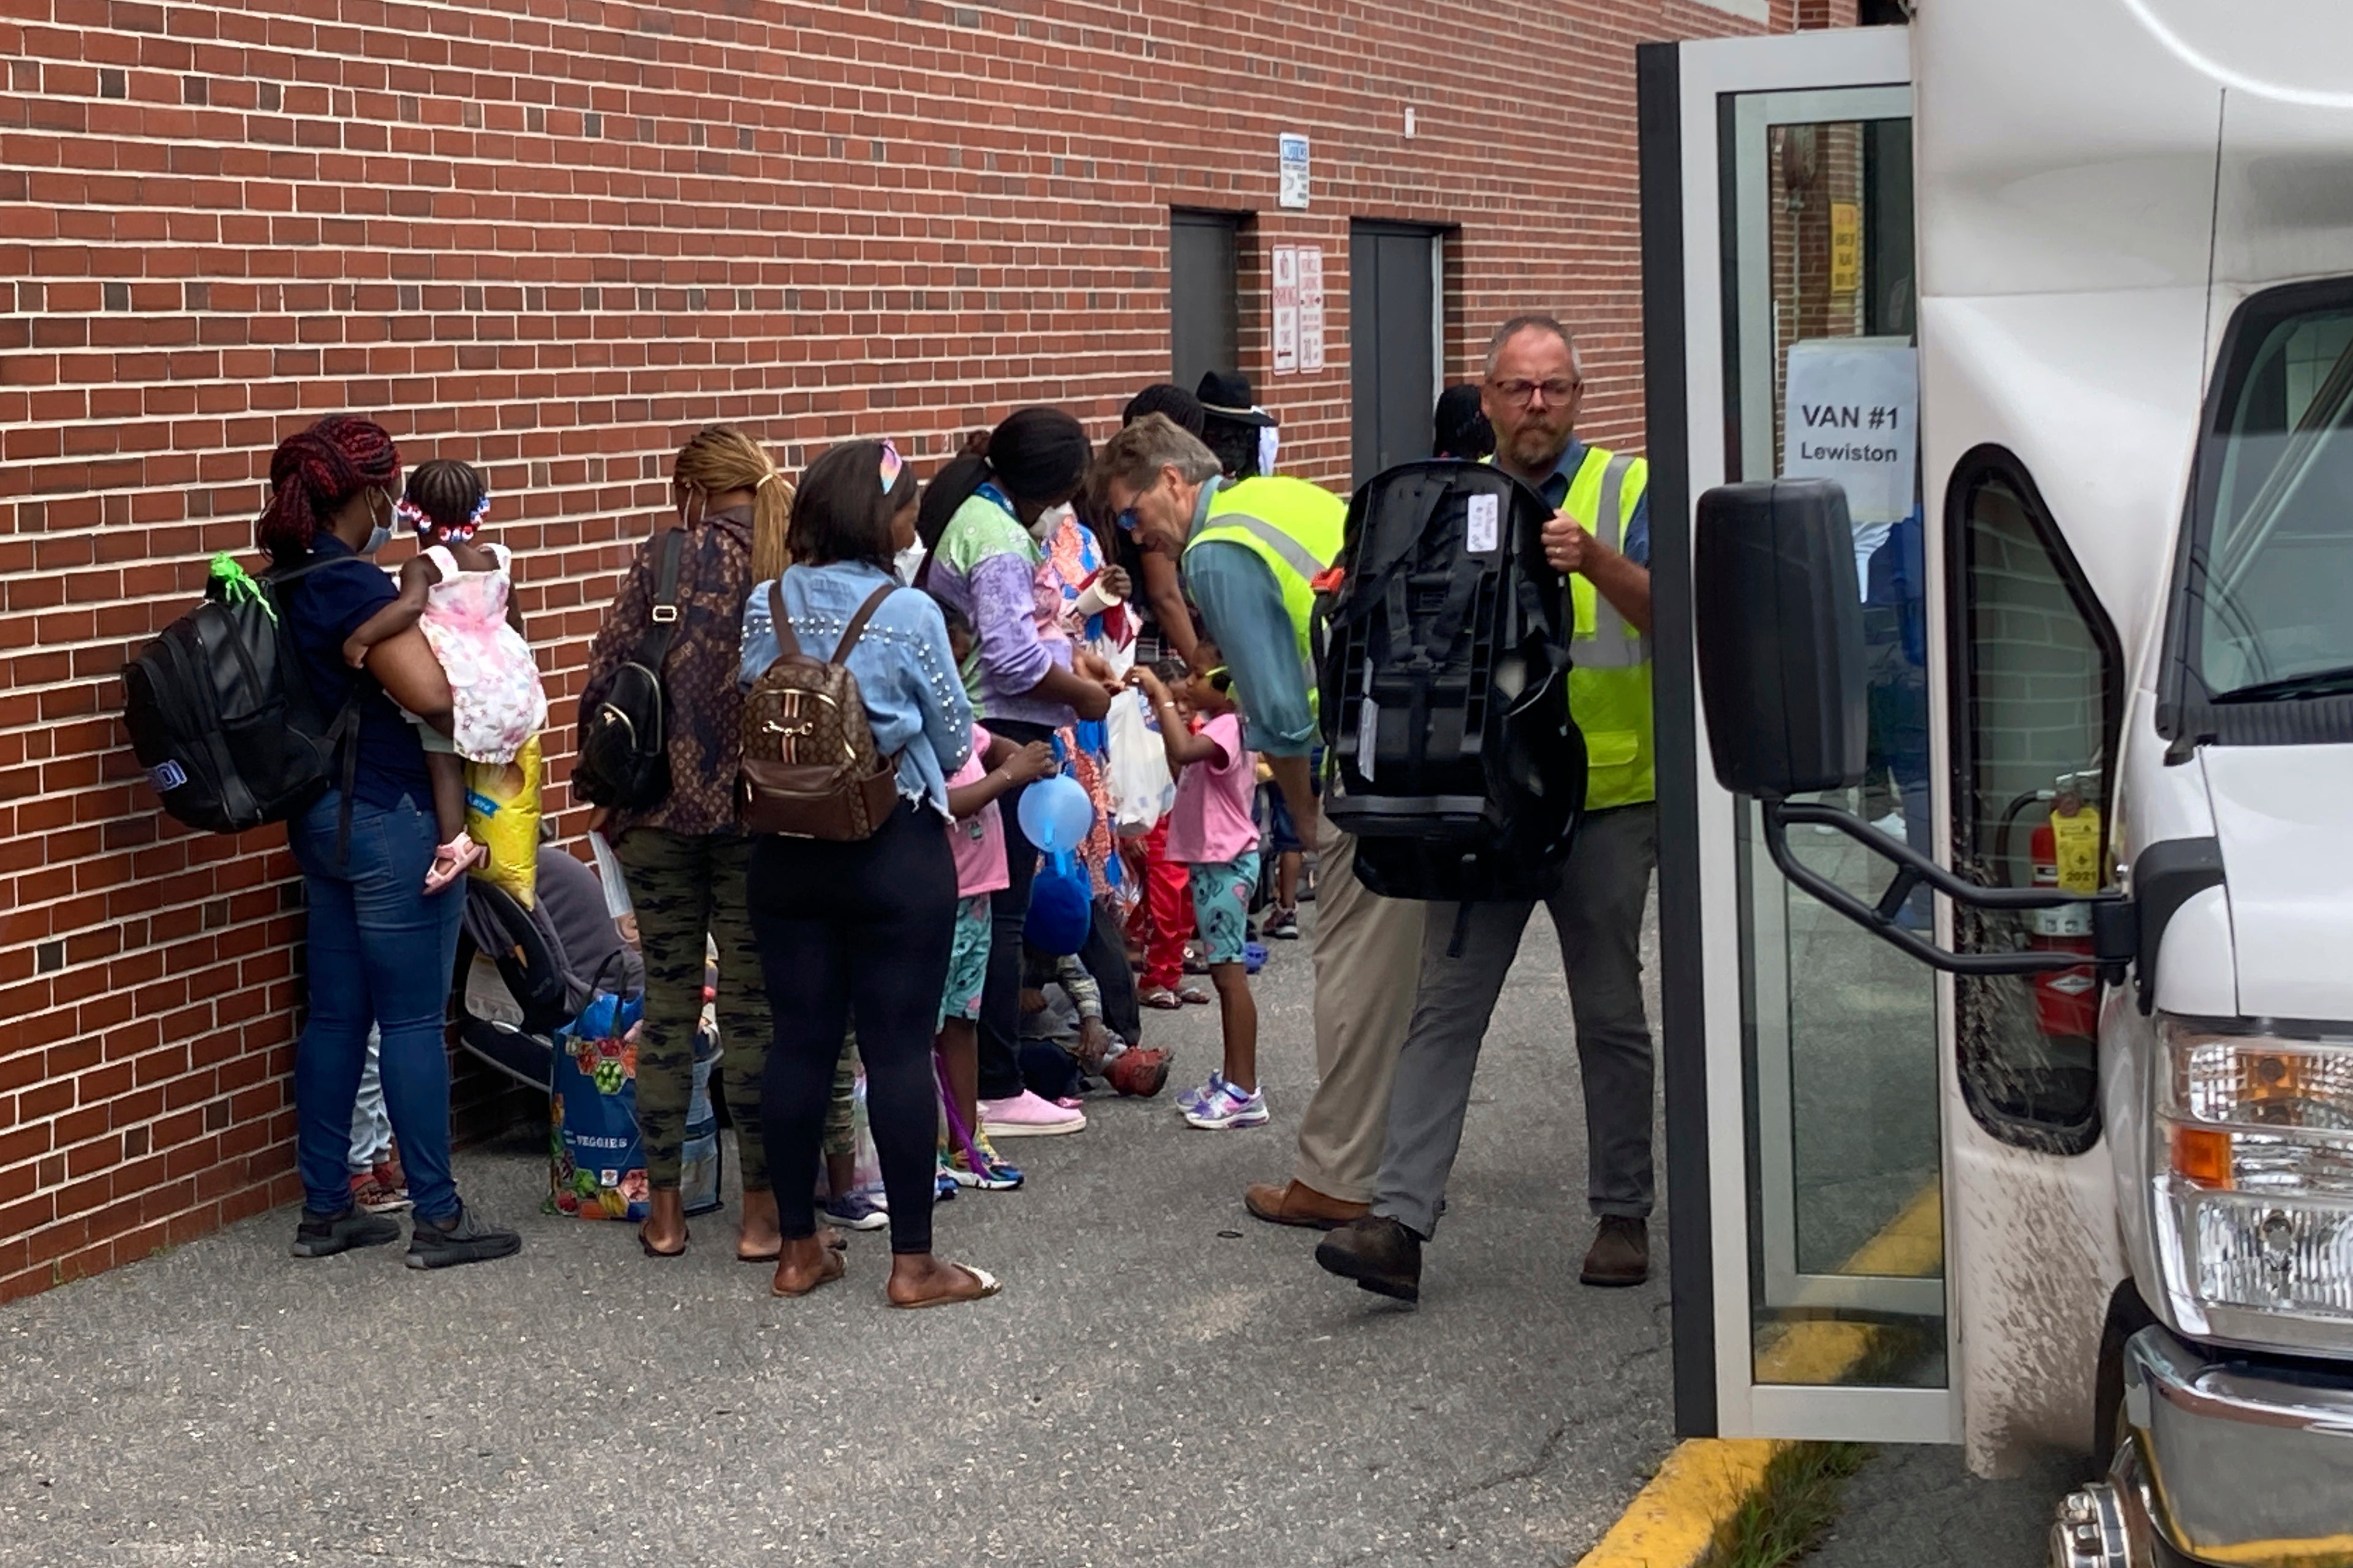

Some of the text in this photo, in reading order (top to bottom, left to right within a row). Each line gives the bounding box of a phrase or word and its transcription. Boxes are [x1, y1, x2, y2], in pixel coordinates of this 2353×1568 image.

[1802, 404, 1898, 430] VAN #1
[1801, 441, 1898, 462] Lewiston
[2066, 870, 2096, 881] 2021
[576, 1134, 628, 1149] VEGGIES
